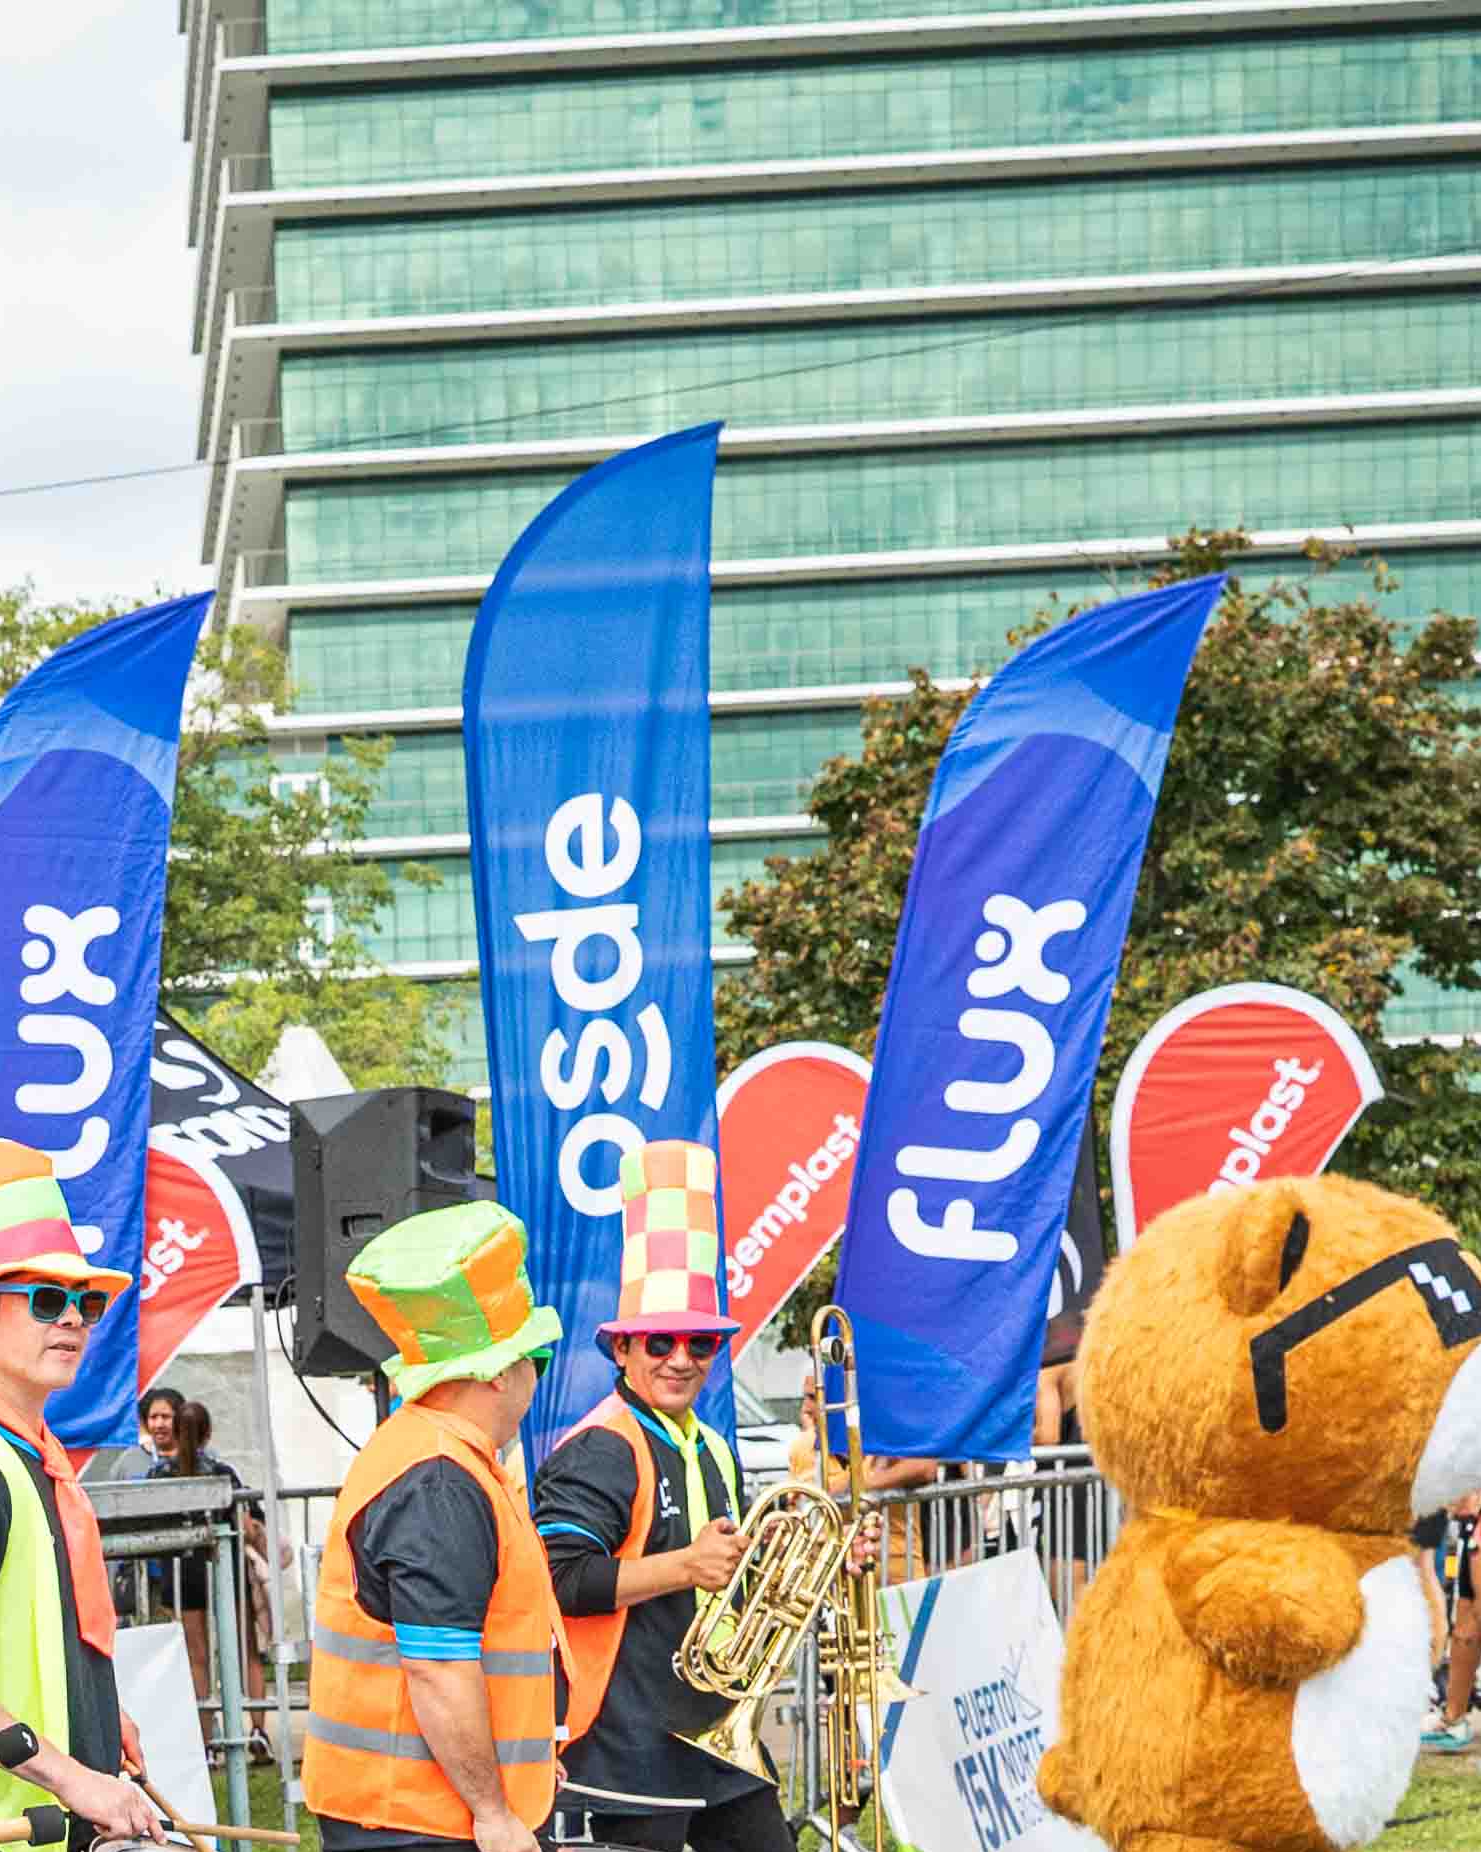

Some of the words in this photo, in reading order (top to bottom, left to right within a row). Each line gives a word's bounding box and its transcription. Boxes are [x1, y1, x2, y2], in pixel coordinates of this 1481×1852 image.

[515, 793, 643, 1218] osde
[725, 1113, 862, 1299] gemplast
[1208, 1057, 1324, 1198] plast
[953, 1679, 1019, 1744] PUERTO
